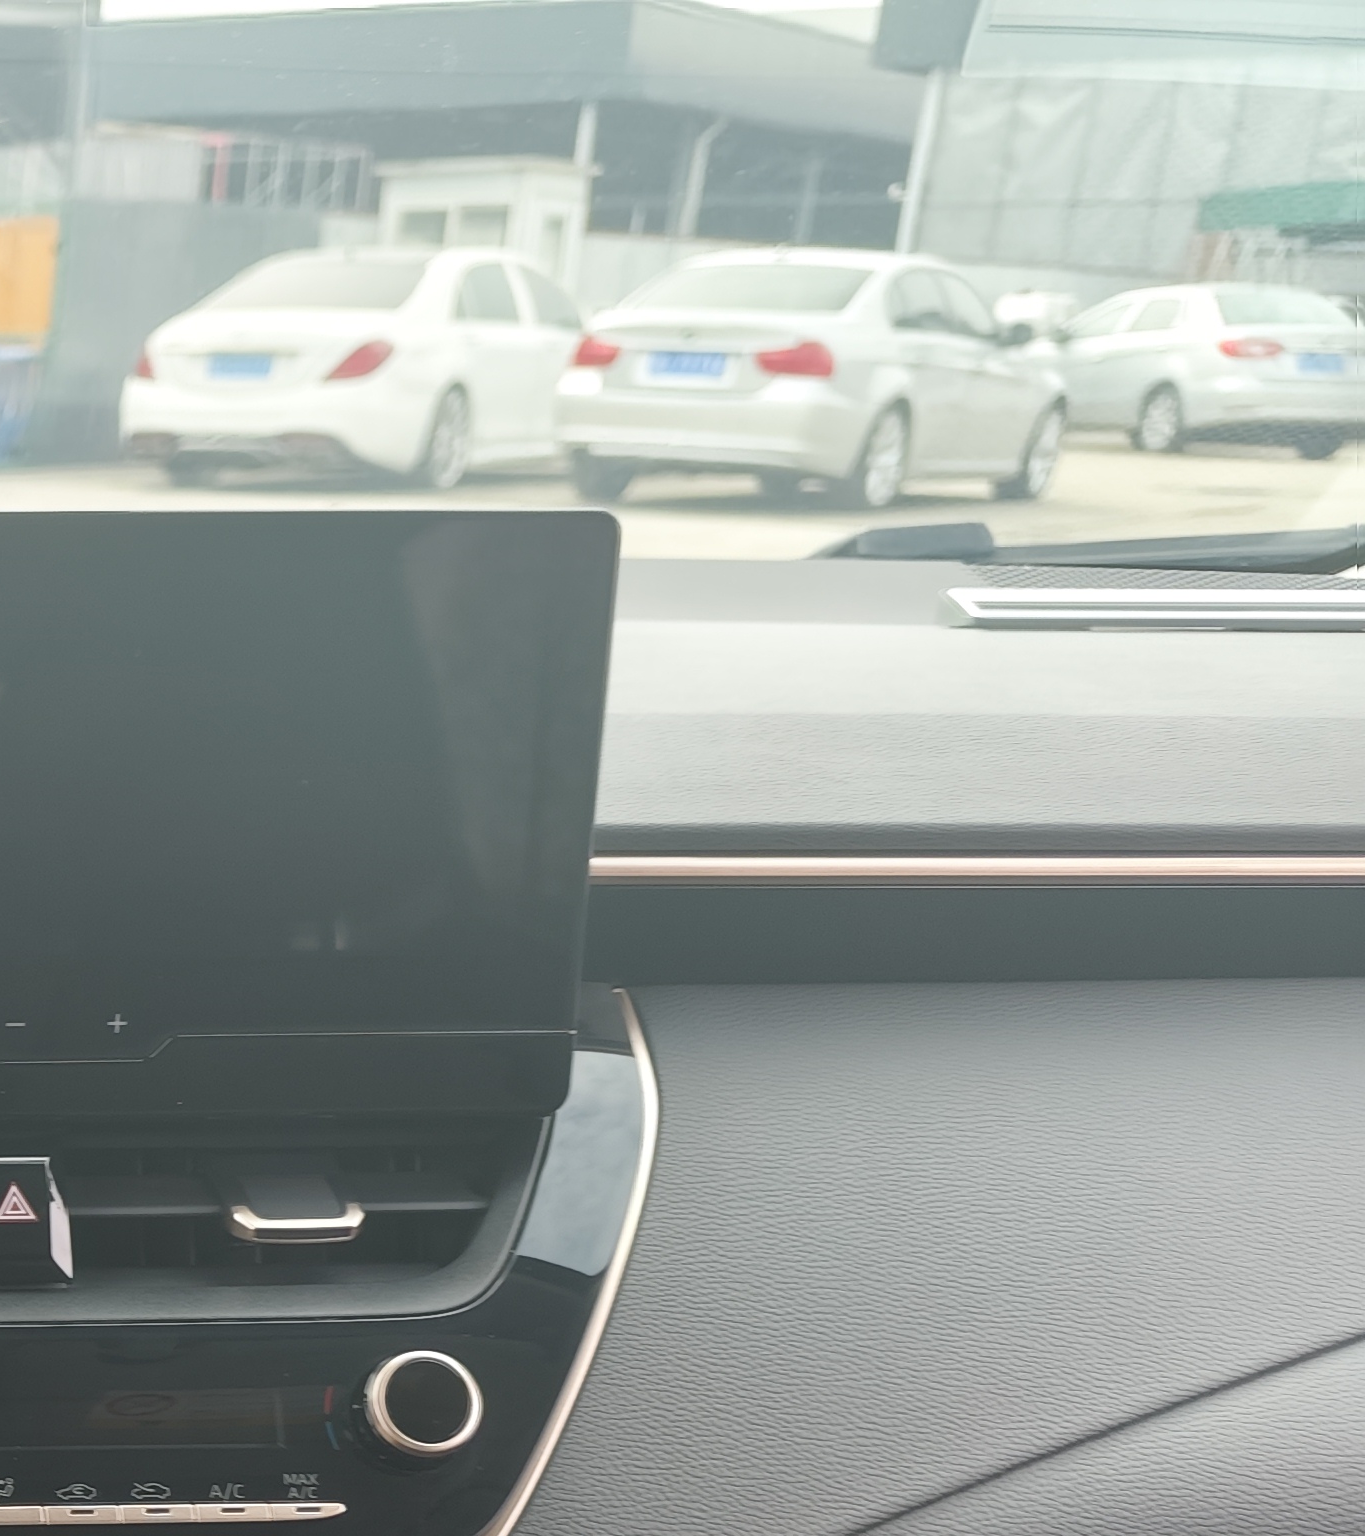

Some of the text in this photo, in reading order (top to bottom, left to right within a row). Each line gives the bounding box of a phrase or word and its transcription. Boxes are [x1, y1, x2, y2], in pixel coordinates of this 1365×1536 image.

[282, 1473, 320, 1486] MAX
[208, 1483, 246, 1500] A/C
[287, 1486, 319, 1500] A/C
